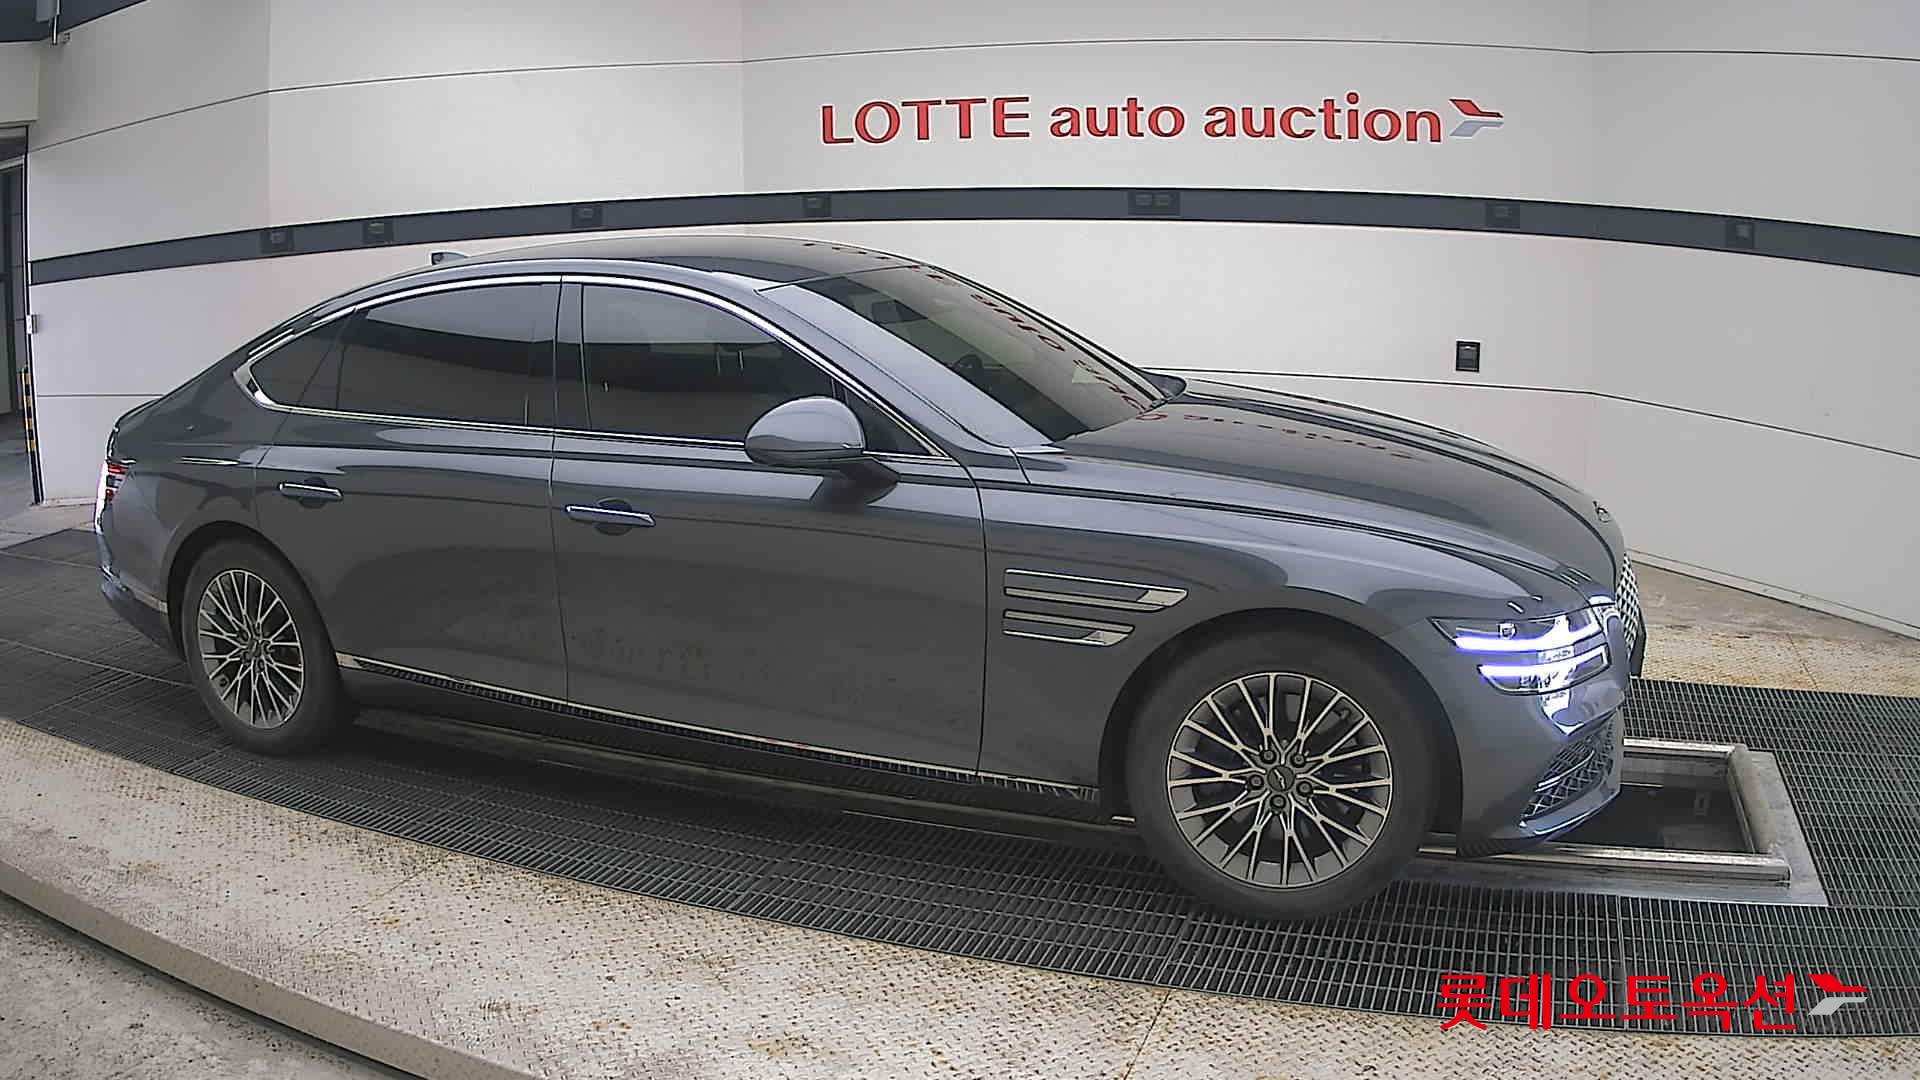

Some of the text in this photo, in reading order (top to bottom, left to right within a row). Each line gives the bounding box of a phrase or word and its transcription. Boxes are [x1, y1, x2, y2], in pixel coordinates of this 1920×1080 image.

[822, 92, 1443, 145] LOTTE auto auction
